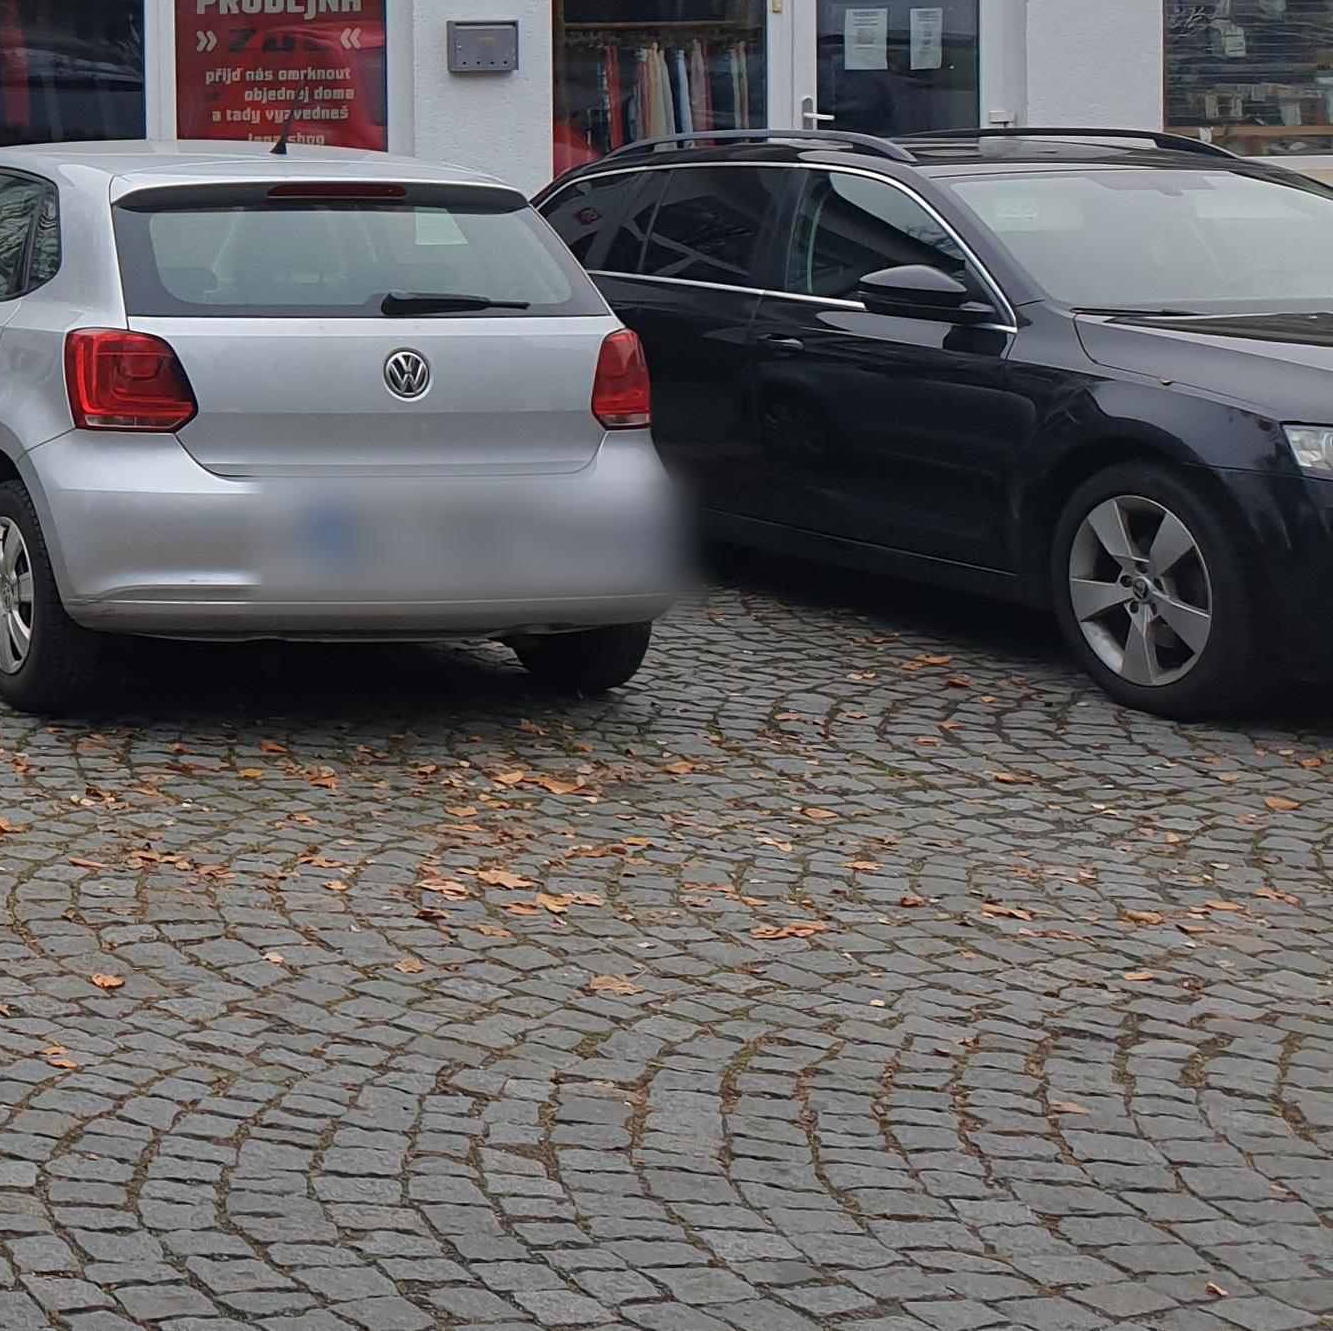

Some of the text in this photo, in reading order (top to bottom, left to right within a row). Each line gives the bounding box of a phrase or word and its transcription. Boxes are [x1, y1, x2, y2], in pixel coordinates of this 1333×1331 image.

[245, 67, 273, 81] nás
[278, 67, 351, 81] omrknout
[314, 87, 355, 100] doma
[212, 110, 221, 121] a
[226, 107, 261, 124] tady
